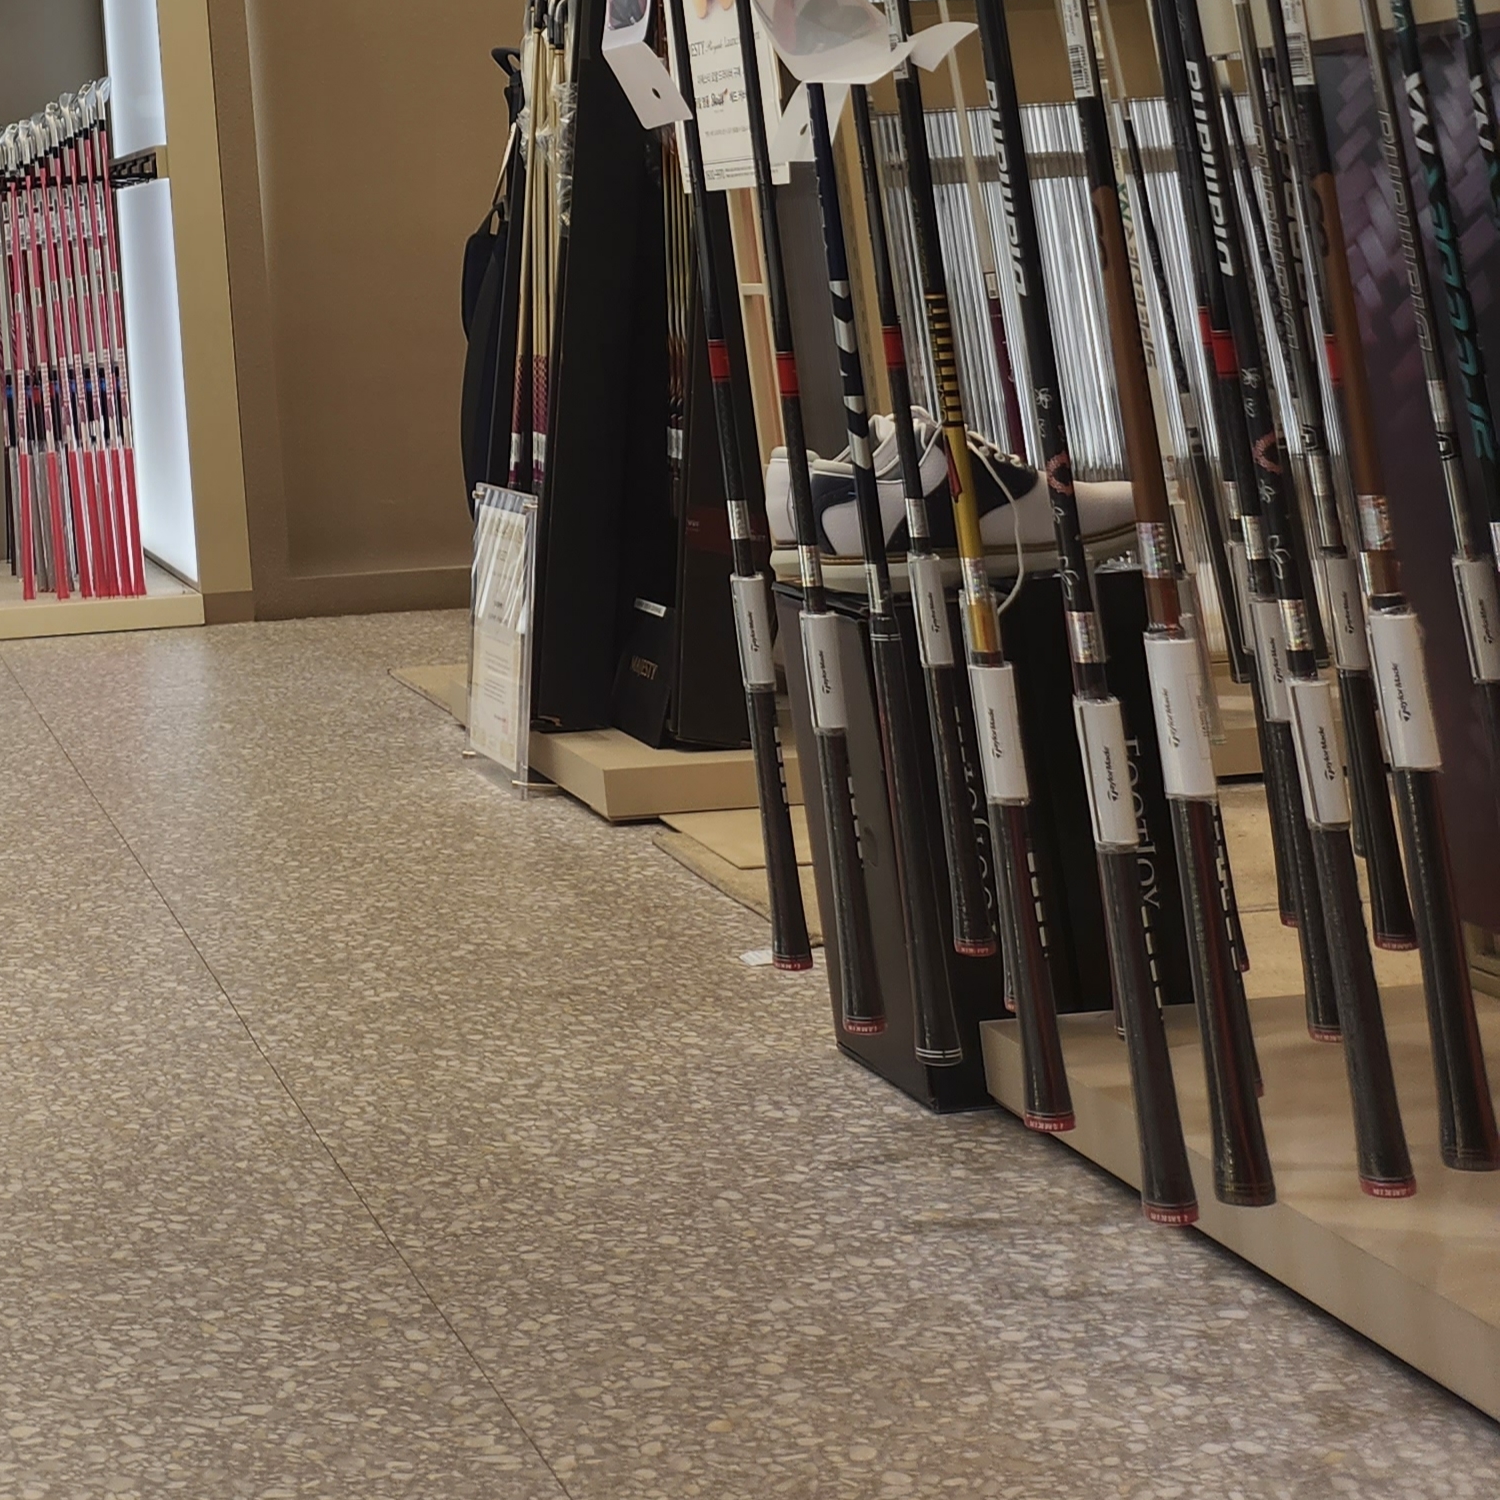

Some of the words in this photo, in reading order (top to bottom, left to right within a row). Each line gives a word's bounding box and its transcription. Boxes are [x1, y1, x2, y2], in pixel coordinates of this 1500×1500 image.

[747, 610, 759, 652] TaylorMade
[927, 591, 940, 633] TaylorMade
[818, 650, 831, 694] TaylorMade
[1270, 637, 1284, 684] TaylorMade
[1162, 687, 1181, 748] TaylorMade
[1392, 661, 1411, 722] TaylorMade
[988, 707, 1003, 759] TaylorMade
[1317, 726, 1336, 781] TaylorMade
[1103, 745, 1119, 802] TaylorMade
